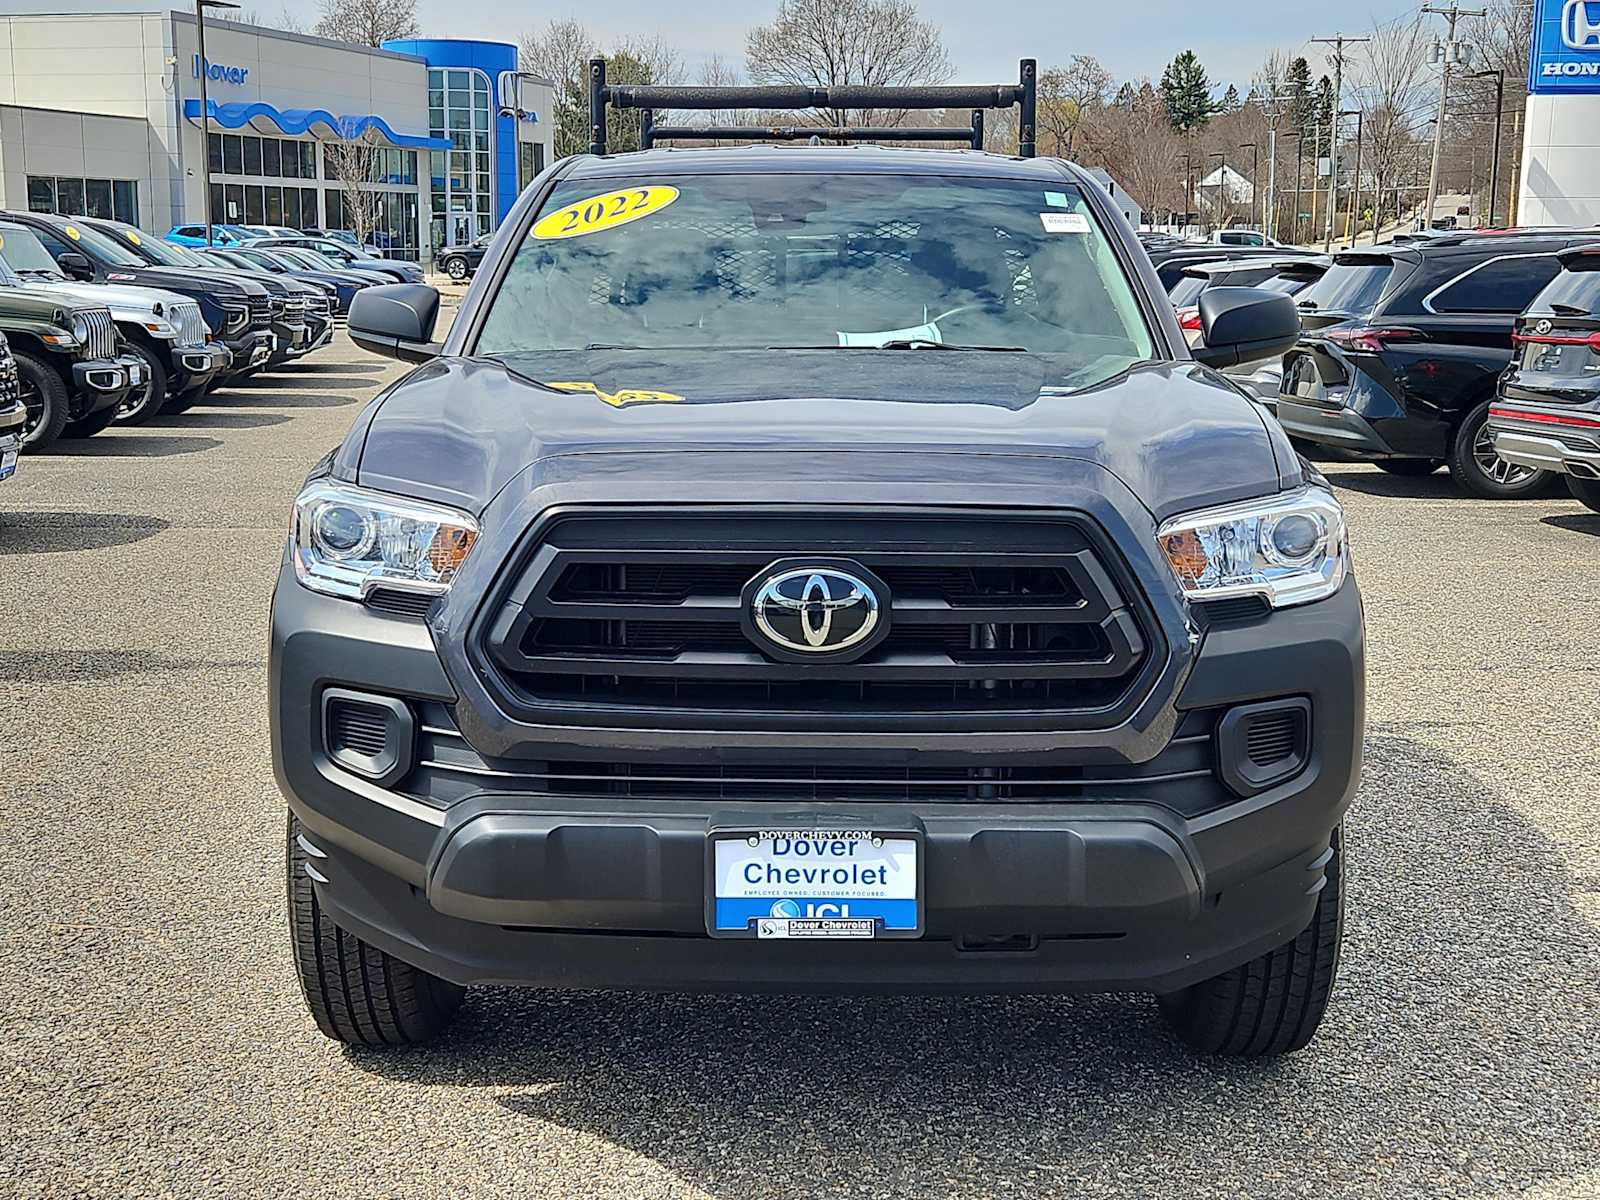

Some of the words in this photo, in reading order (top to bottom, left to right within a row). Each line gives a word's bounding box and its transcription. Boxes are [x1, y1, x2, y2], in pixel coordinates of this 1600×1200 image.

[192, 54, 248, 84] Dover
[561, 190, 649, 232] 2022
[758, 831, 872, 840] DOVERCHEVY.COM
[772, 839, 859, 856] Dover
[744, 863, 887, 885] Chevrolet
[790, 921, 820, 930] Dover
[823, 921, 871, 930] Chevrolet
